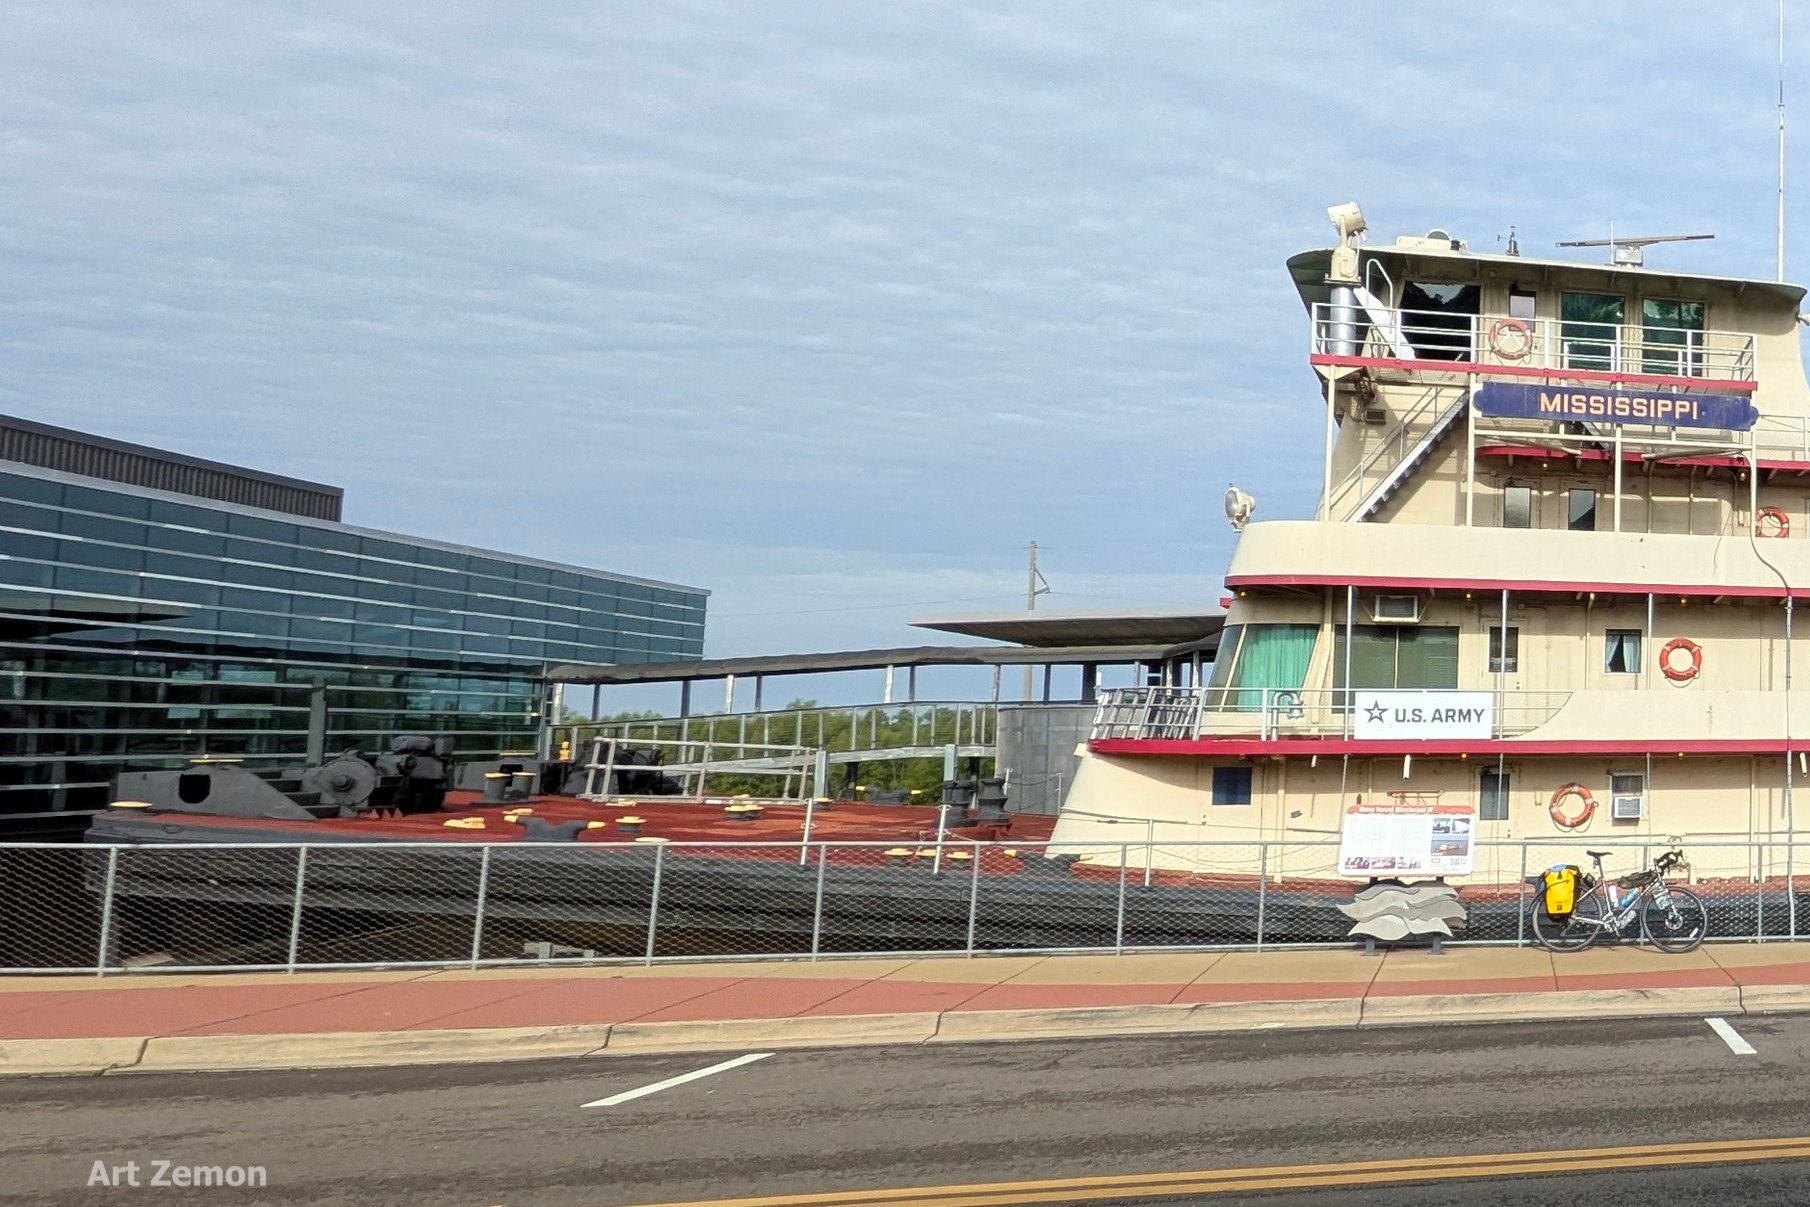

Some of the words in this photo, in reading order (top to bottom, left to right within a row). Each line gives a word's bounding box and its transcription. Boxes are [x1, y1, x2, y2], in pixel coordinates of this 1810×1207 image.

[1540, 392, 1699, 421] MISSISSIPPI
[1395, 708, 1427, 723] U.S.
[1431, 708, 1485, 723] ARMY
